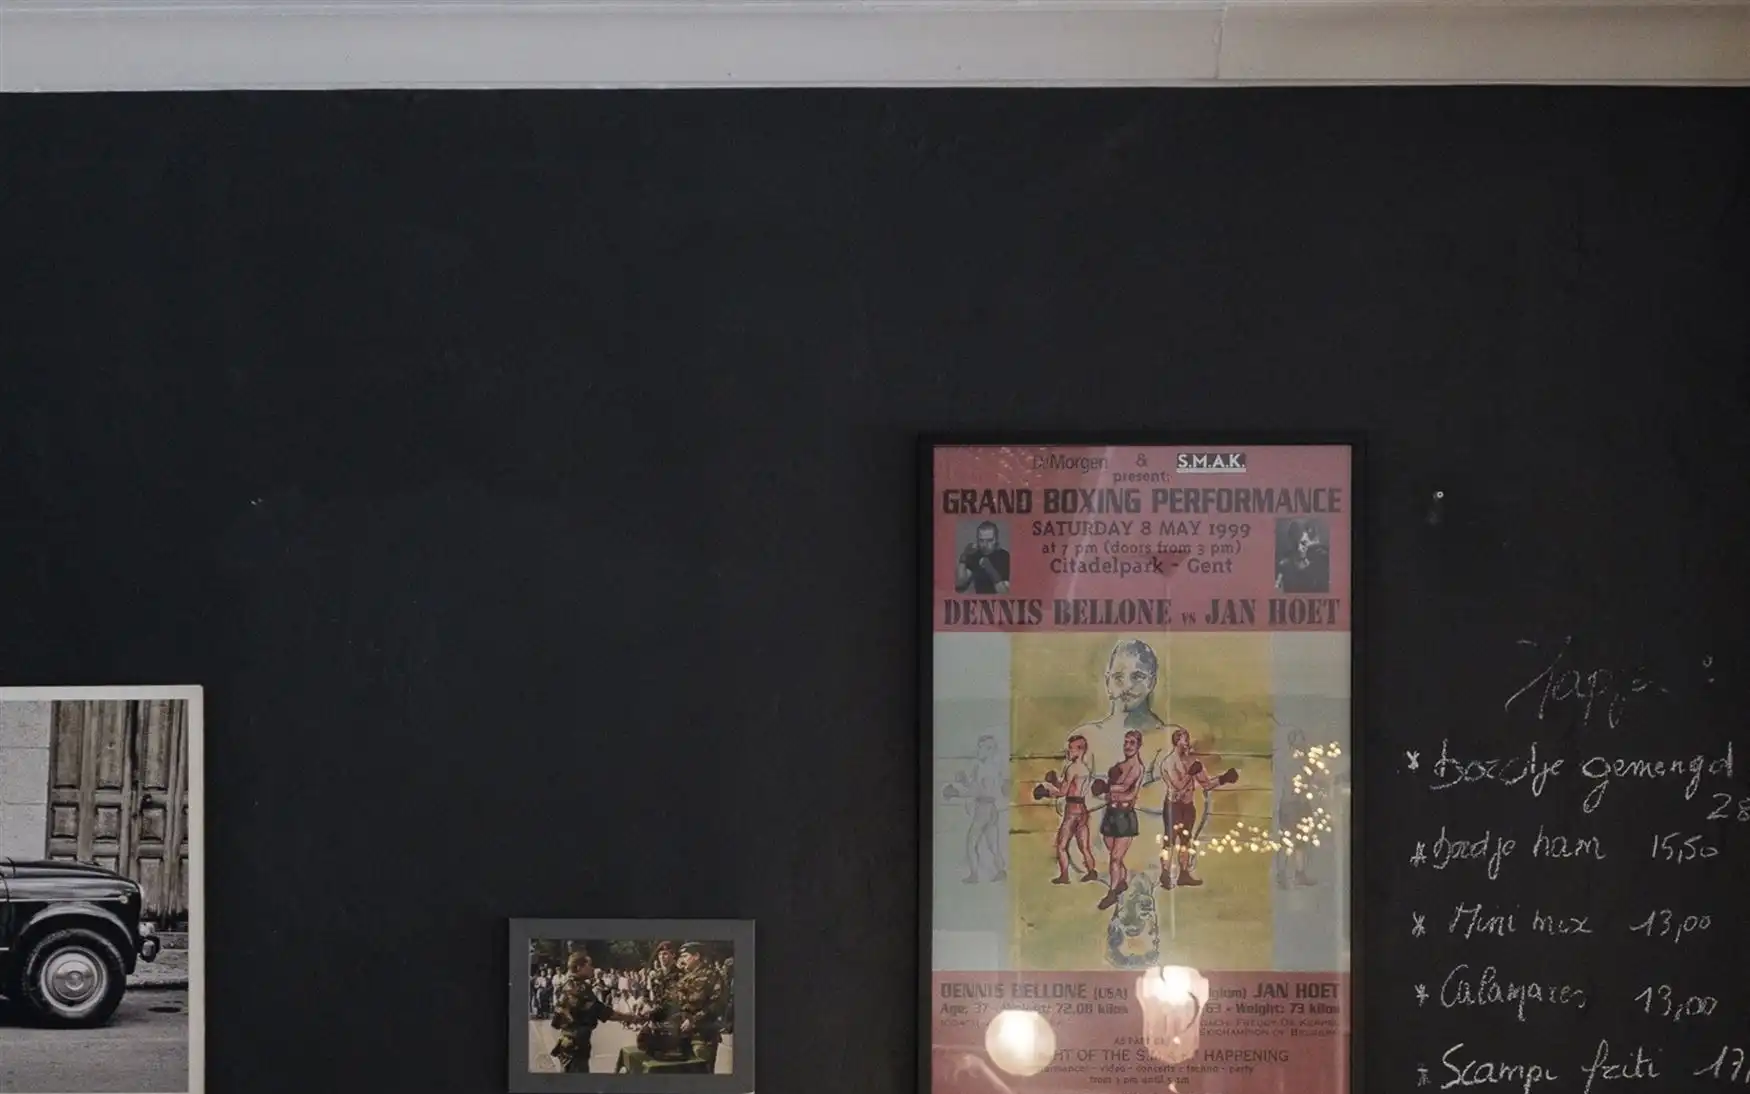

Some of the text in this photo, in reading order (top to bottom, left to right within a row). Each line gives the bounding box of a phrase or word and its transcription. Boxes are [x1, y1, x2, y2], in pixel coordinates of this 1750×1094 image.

[1136, 453, 1148, 467] &
[1178, 453, 1245, 468] S.M.A.K.
[943, 487, 1342, 515] GRAND BOXING PERFORMANCE
[1032, 520, 1252, 539] SATURDAY 8 MAY 1999
[1042, 542, 1056, 554] at
[1061, 544, 1068, 555] 7
[1075, 543, 1098, 557] pm
[1104, 540, 1152, 554] (doors
[1157, 540, 1192, 554] from
[1211, 540, 1242, 557] pm)
[1050, 556, 1163, 578] Citadelpark
[1187, 557, 1233, 573] Gent
[943, 599, 1043, 626] DENNIS
[1053, 599, 1172, 625] BELLONE
[1205, 598, 1256, 625] JAN
[1268, 598, 1341, 626] HOET
[1582, 741, 1734, 813] gemengd
[1533, 825, 1607, 860] ham
[1651, 832, 1719, 864] 15,50
[1629, 908, 1711, 944] 13,00
[940, 983, 1128, 1000] DENNIS BELLONE (USA)
[1253, 983, 1288, 998] JAN
[1295, 983, 1340, 998] HOET
[1235, 1003, 1285, 1015] Weight:
[1290, 1003, 1305, 1014] 73
[1634, 984, 1718, 1022] 13,00
[1077, 1048, 1098, 1062] OF
[1103, 1048, 1131, 1062] THE
[1204, 1049, 1289, 1062] HAPPENING
